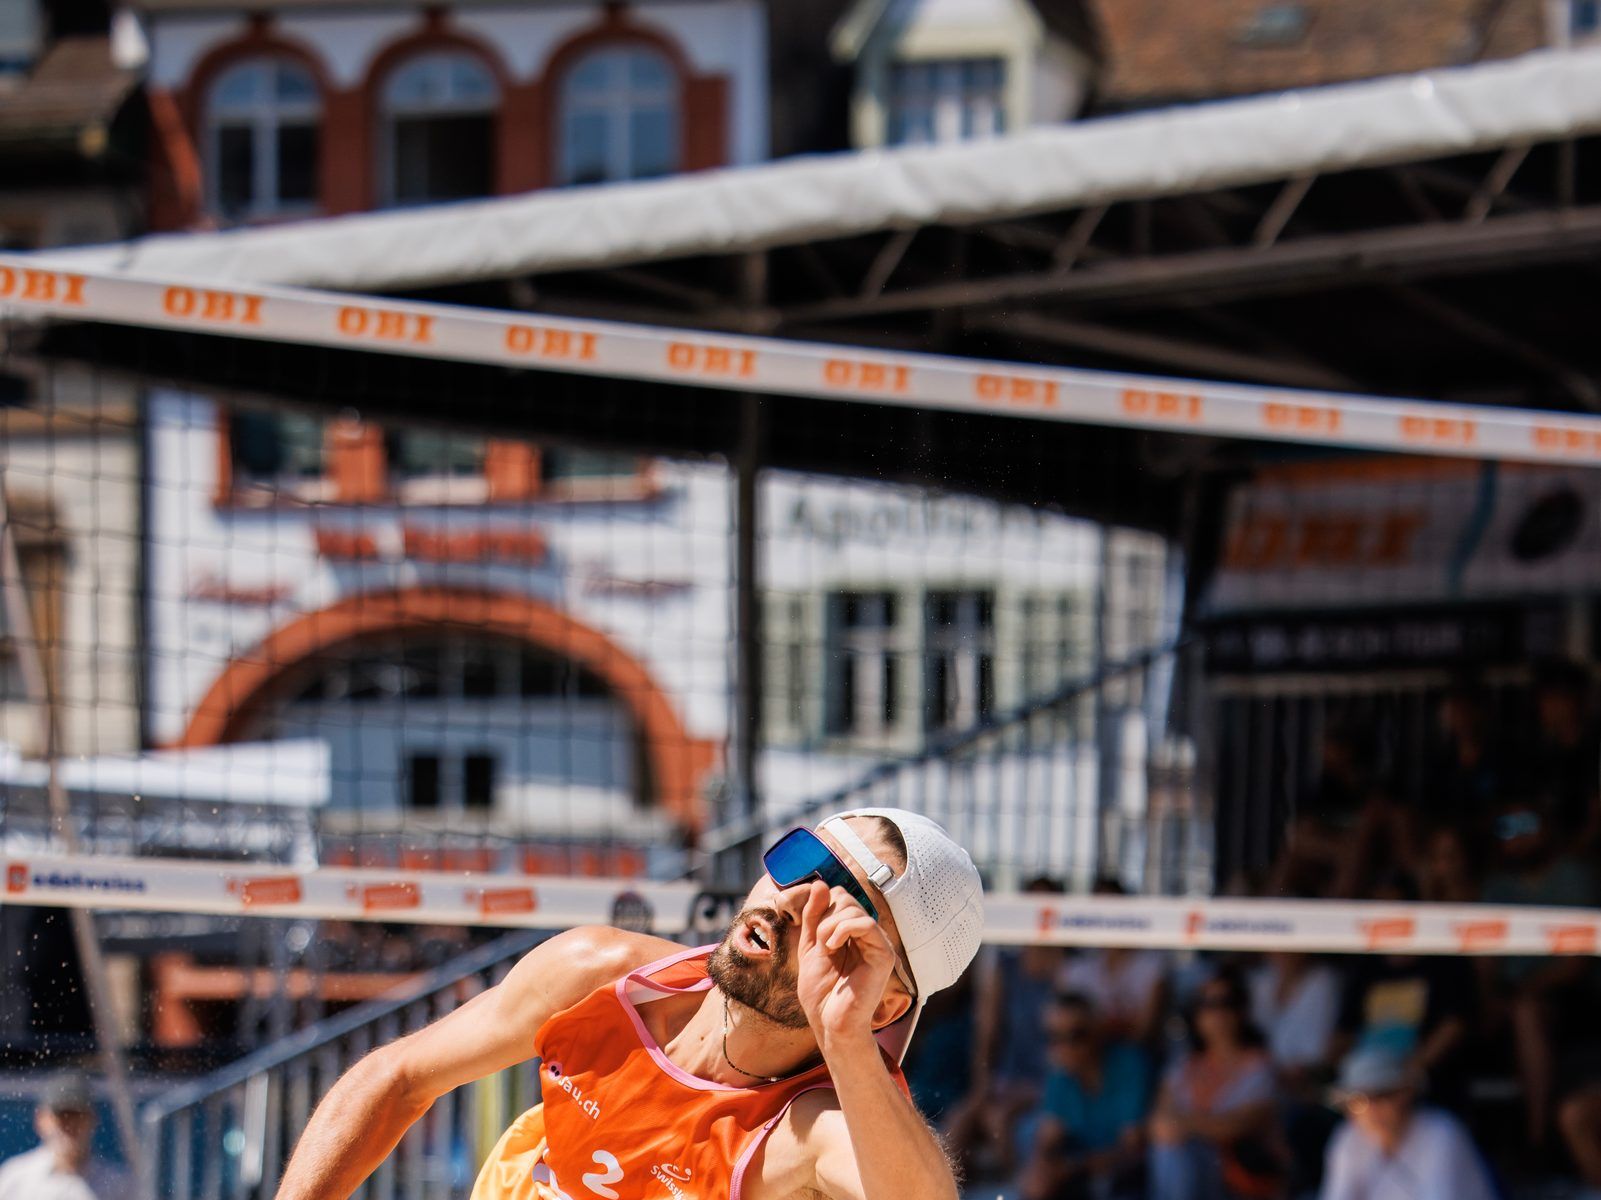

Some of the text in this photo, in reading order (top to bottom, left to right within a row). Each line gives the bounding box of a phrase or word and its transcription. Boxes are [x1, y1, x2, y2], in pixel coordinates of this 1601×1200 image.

[161, 285, 264, 325] OBI
[335, 305, 434, 344] OBI
[503, 324, 597, 361] OBI
[665, 341, 757, 378] OBI
[822, 357, 910, 393] OBI
[973, 373, 1058, 408] OBI
[1120, 389, 1203, 422] OBI
[1262, 402, 1341, 433] OBI
[582, 1150, 624, 1200] 2
